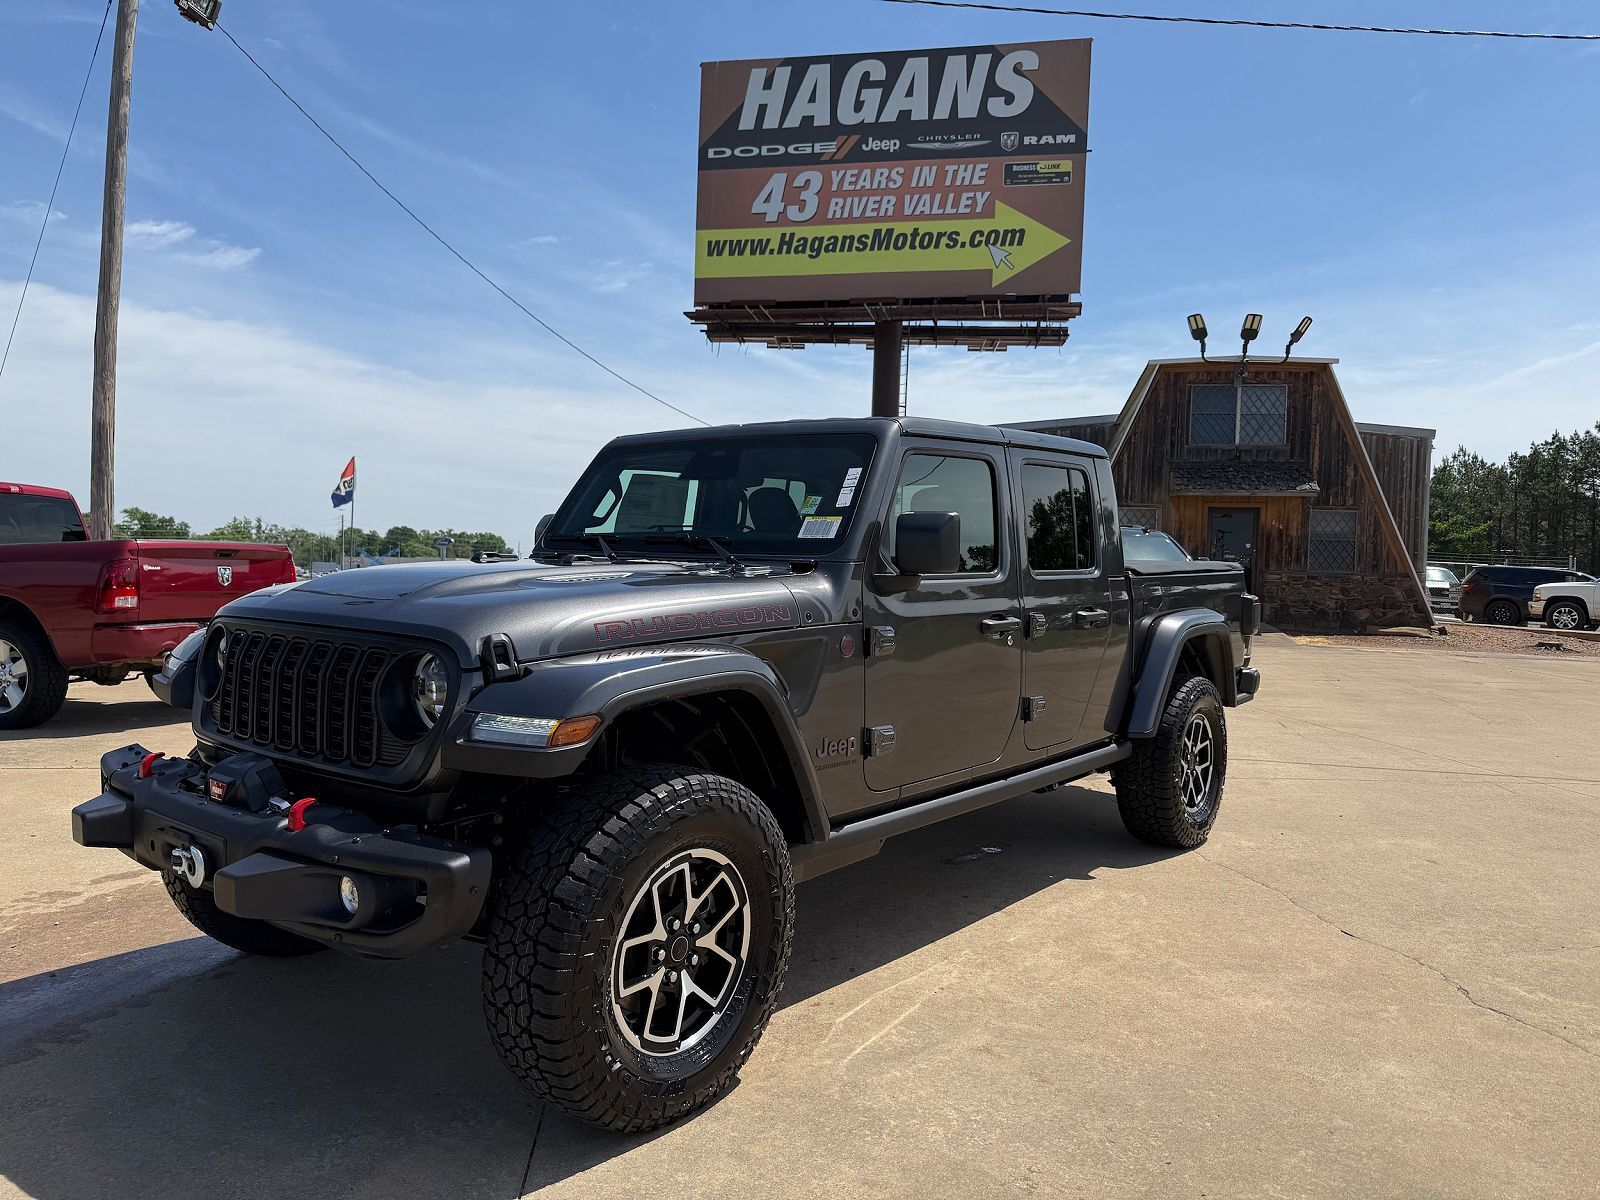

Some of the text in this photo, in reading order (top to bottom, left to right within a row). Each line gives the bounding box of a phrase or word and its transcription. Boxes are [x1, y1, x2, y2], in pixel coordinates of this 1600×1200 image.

[738, 50, 1040, 131] HAGANS
[707, 141, 838, 159] DODGE
[861, 136, 900, 153] Jeep
[917, 133, 981, 142] CHRYSLER
[1023, 134, 1076, 145] RAM
[830, 163, 989, 192] YEARS IN THE
[1012, 164, 1036, 172] BUSINESS
[751, 170, 823, 222] 43
[826, 191, 991, 219] RIVER VALLEY
[706, 227, 1026, 259] www.HagansMotors.com
[594, 605, 791, 643] RUBICON
[815, 736, 856, 759] Jeep
